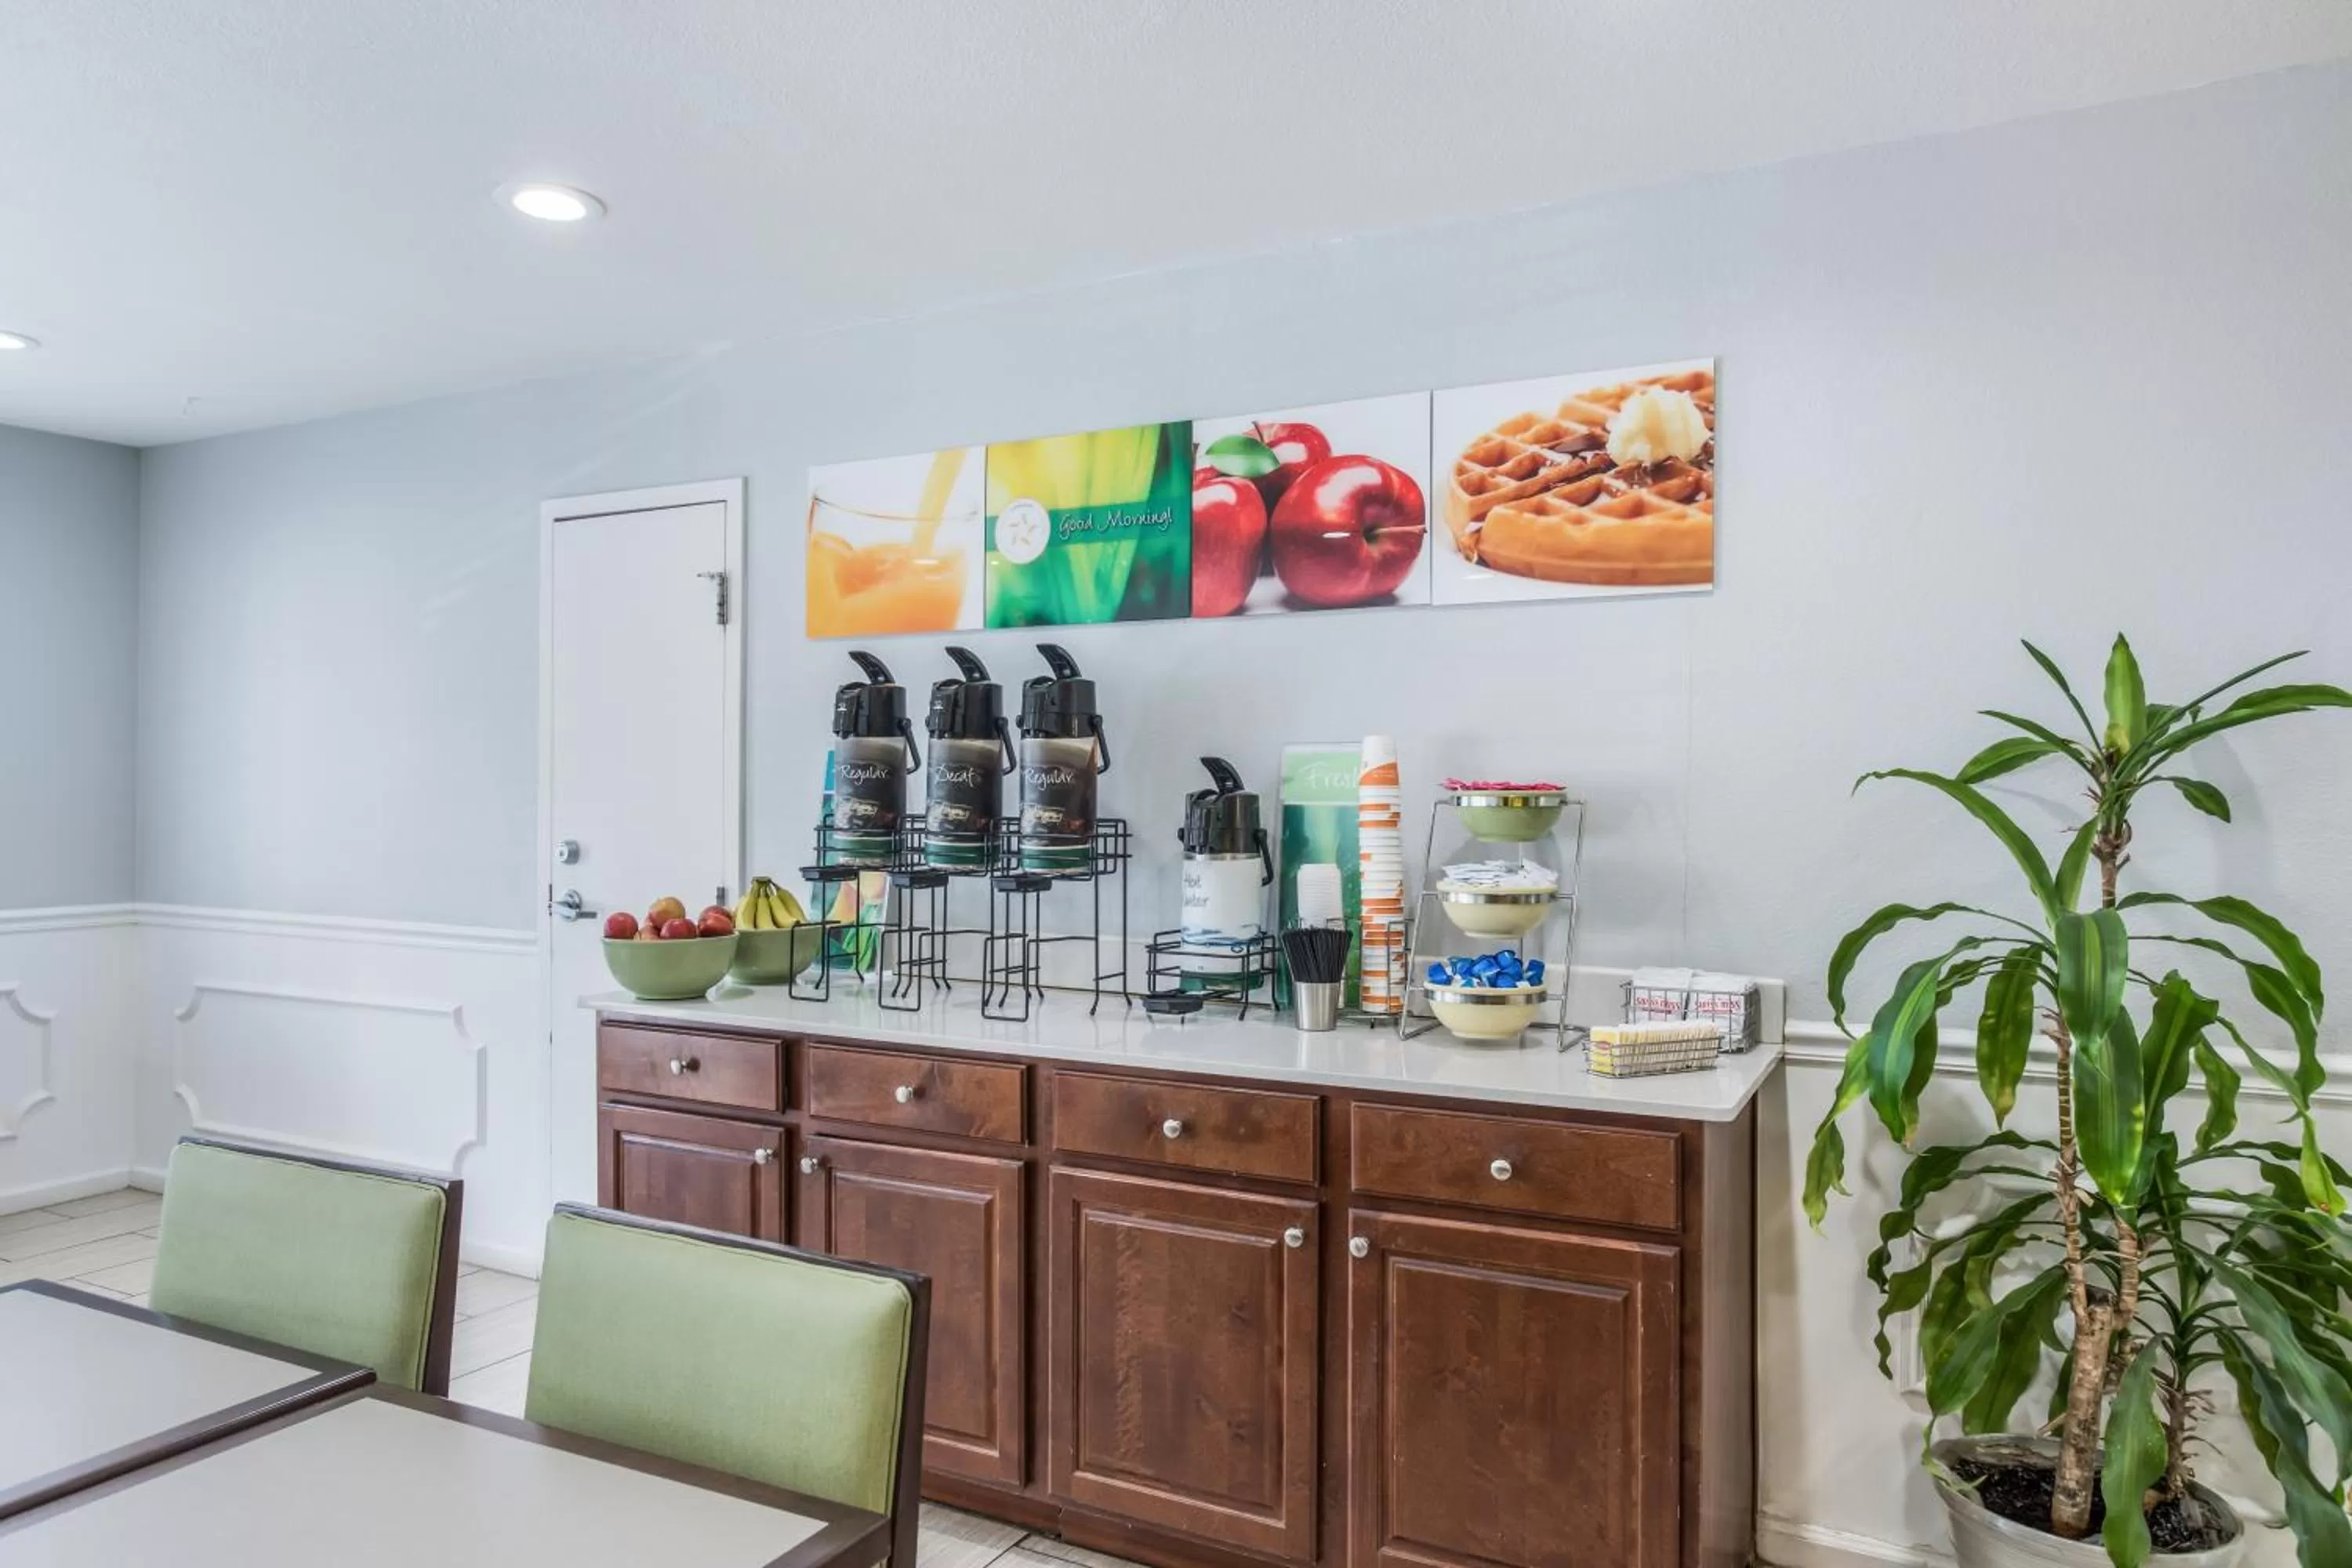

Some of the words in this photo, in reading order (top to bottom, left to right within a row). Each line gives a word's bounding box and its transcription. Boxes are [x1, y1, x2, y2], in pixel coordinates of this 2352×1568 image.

[1059, 514, 1093, 540] Good
[1098, 506, 1172, 534] Morning!
[841, 764, 889, 786] Regular
[935, 764, 976, 788] Decaf
[1025, 768, 1073, 791] Regular
